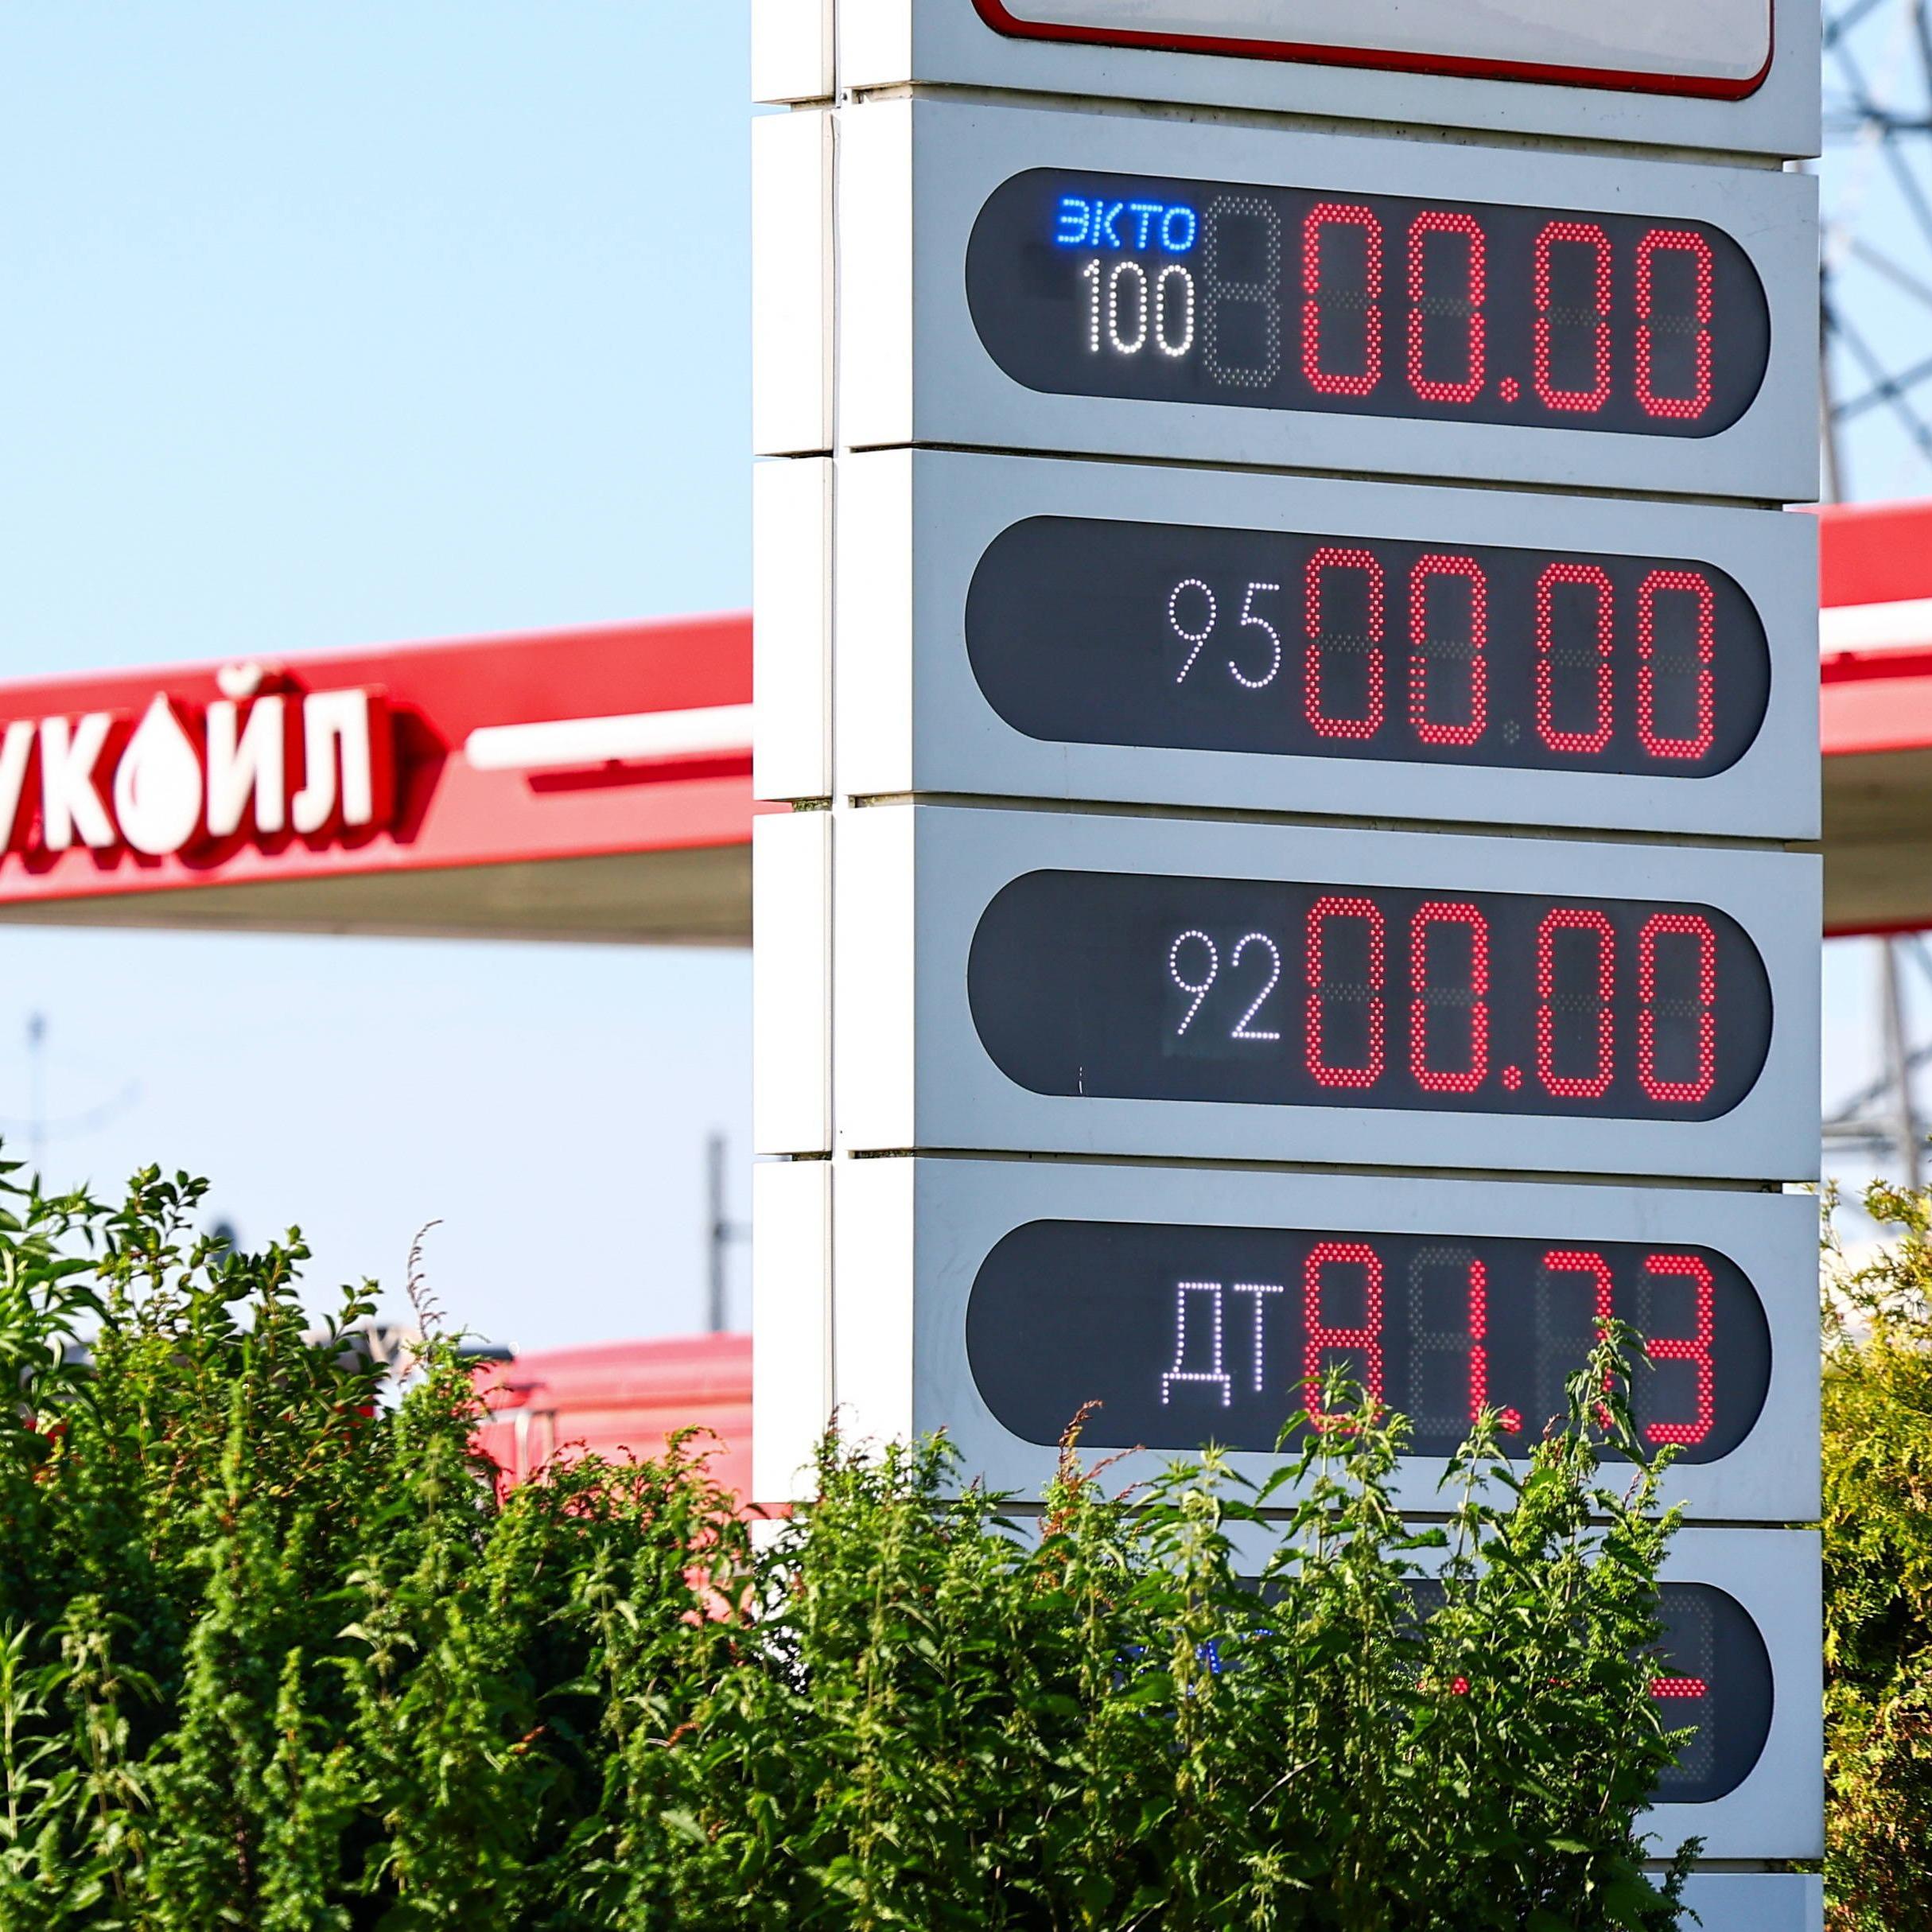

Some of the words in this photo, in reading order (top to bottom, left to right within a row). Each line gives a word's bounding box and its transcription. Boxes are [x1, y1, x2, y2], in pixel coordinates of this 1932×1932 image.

[1057, 198, 1196, 251] ЭКТО
[1083, 259, 1195, 357] 100
[1302, 202, 1713, 420] 00.00
[1168, 577, 1282, 690] 95
[1169, 930, 1282, 1040] 92
[1306, 896, 1716, 1102] 00.00
[1161, 1281, 1285, 1407] ДТ
